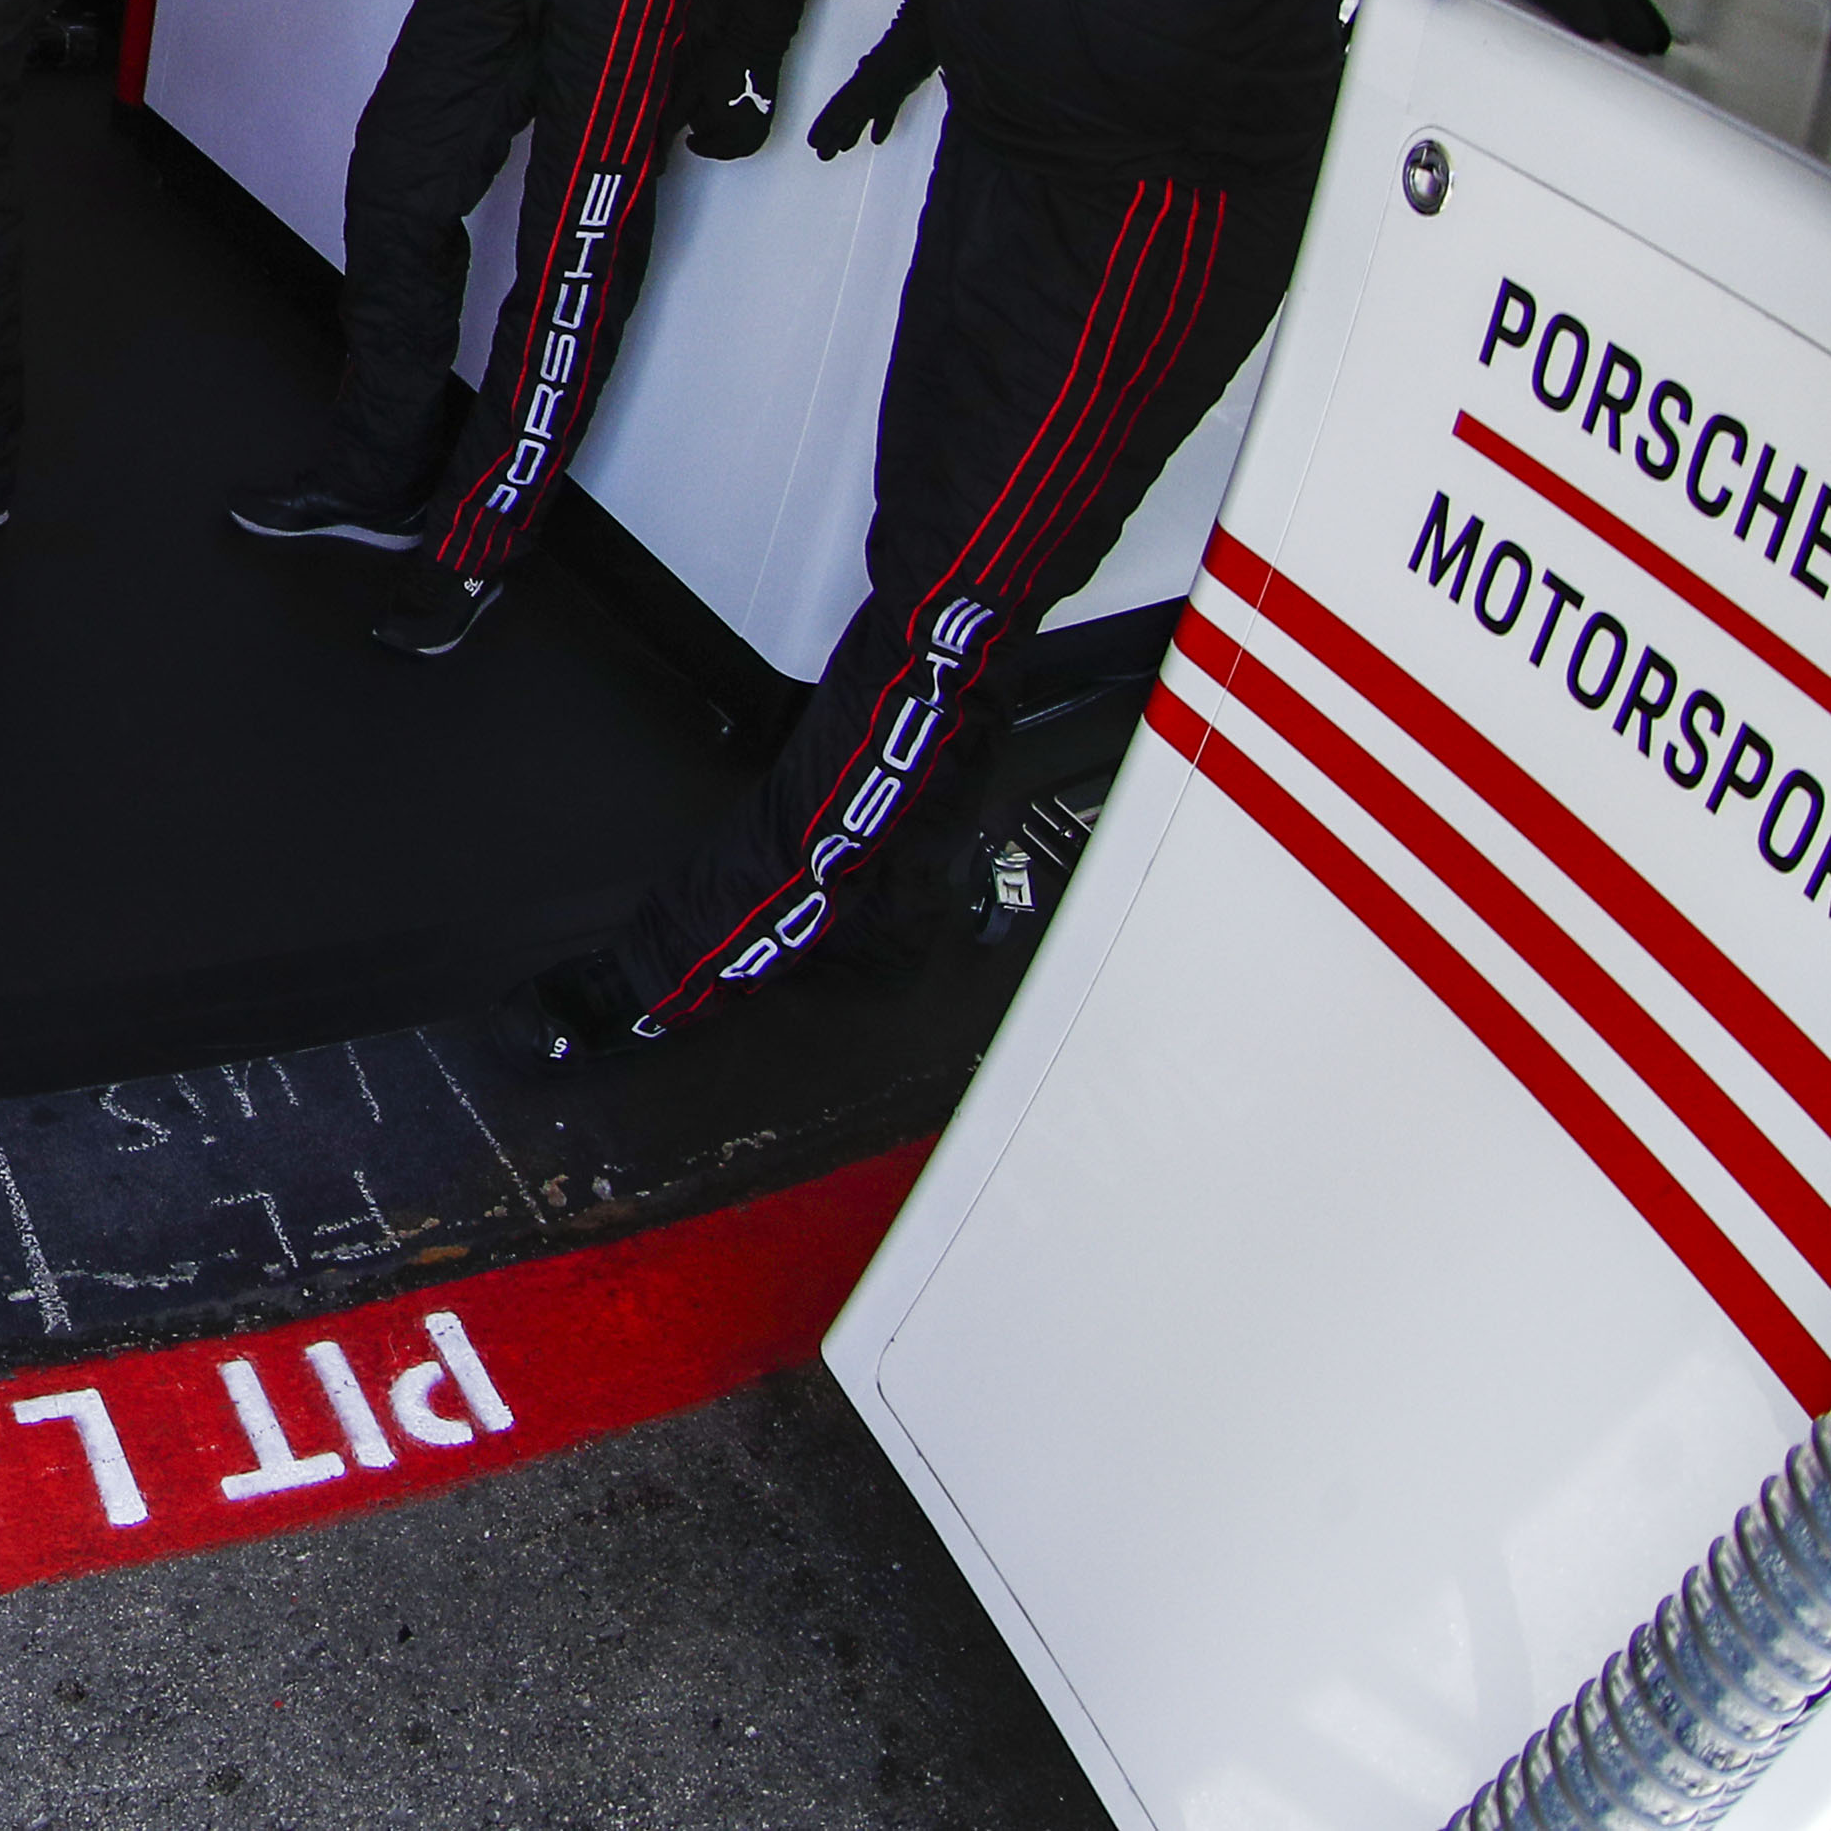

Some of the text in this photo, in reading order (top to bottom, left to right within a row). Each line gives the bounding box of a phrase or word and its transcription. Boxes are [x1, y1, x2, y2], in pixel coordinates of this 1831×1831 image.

[486, 173, 623, 514] PORSCHE
[1479, 276, 1831, 601] PORSCHE
[719, 596, 995, 979] PORSCHE
[219, 1310, 515, 1501] PIT
